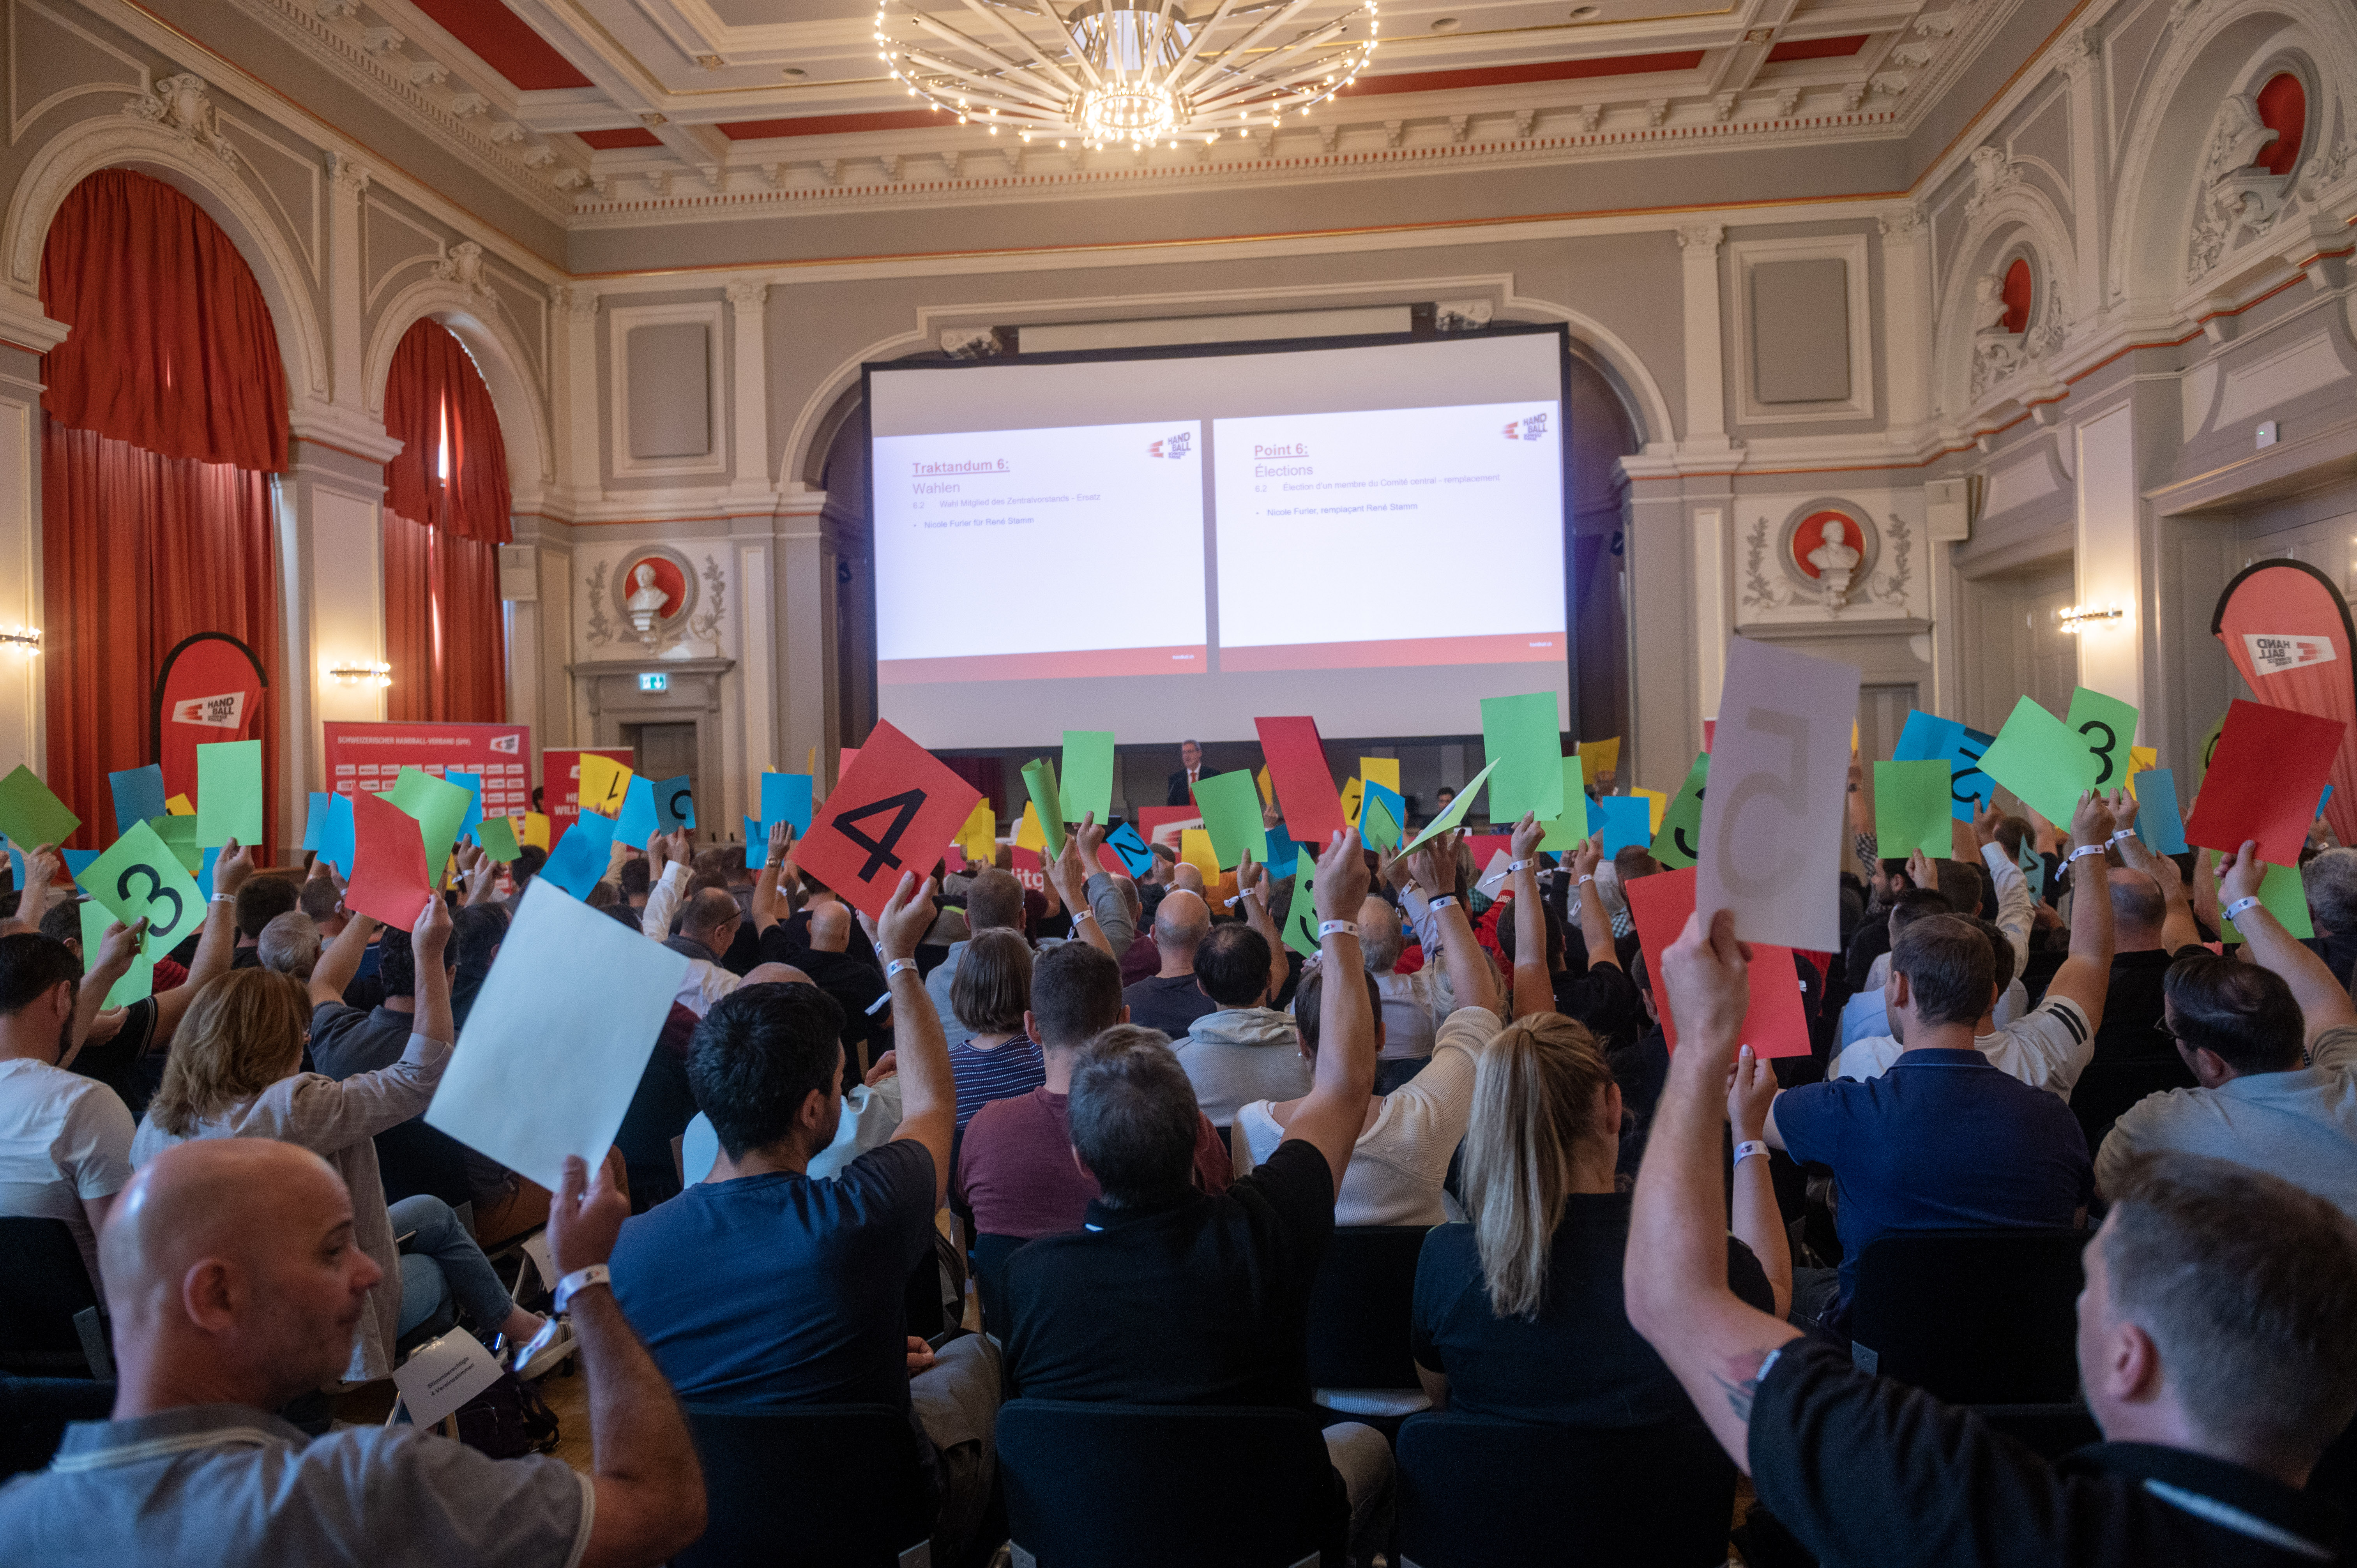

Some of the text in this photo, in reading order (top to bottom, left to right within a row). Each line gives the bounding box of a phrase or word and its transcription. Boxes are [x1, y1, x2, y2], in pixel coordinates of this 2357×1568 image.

[1523, 413, 1547, 426] HAND
[1528, 423, 1548, 433] BALL
[1168, 432, 1191, 445] HAND
[1172, 442, 1191, 452] BALL
[1254, 443, 1308, 456] Point 6:
[912, 458, 1009, 474] Traktandum 6:
[1255, 463, 1314, 477] Élections
[913, 482, 960, 494] Wahlen
[1283, 482, 1314, 491] Élection
[1335, 481, 1366, 489] membre
[1380, 478, 1408, 487] Comité
[1410, 477, 1436, 485] central
[1444, 474, 1500, 484] remplacement
[960, 498, 989, 508] Mitglied
[1007, 494, 1069, 505] Zentralvorstands
[1321, 505, 1364, 515] remplaçant
[1366, 503, 1387, 512] René
[208, 696, 234, 708] HAND
[212, 706, 235, 715] BALL
[2078, 720, 2116, 785] 3
[566, 792, 579, 803] HE
[554, 805, 578, 816] WILL
[831, 788, 928, 883] 4
[1114, 832, 1148, 867] 2
[117, 863, 183, 937] 3
